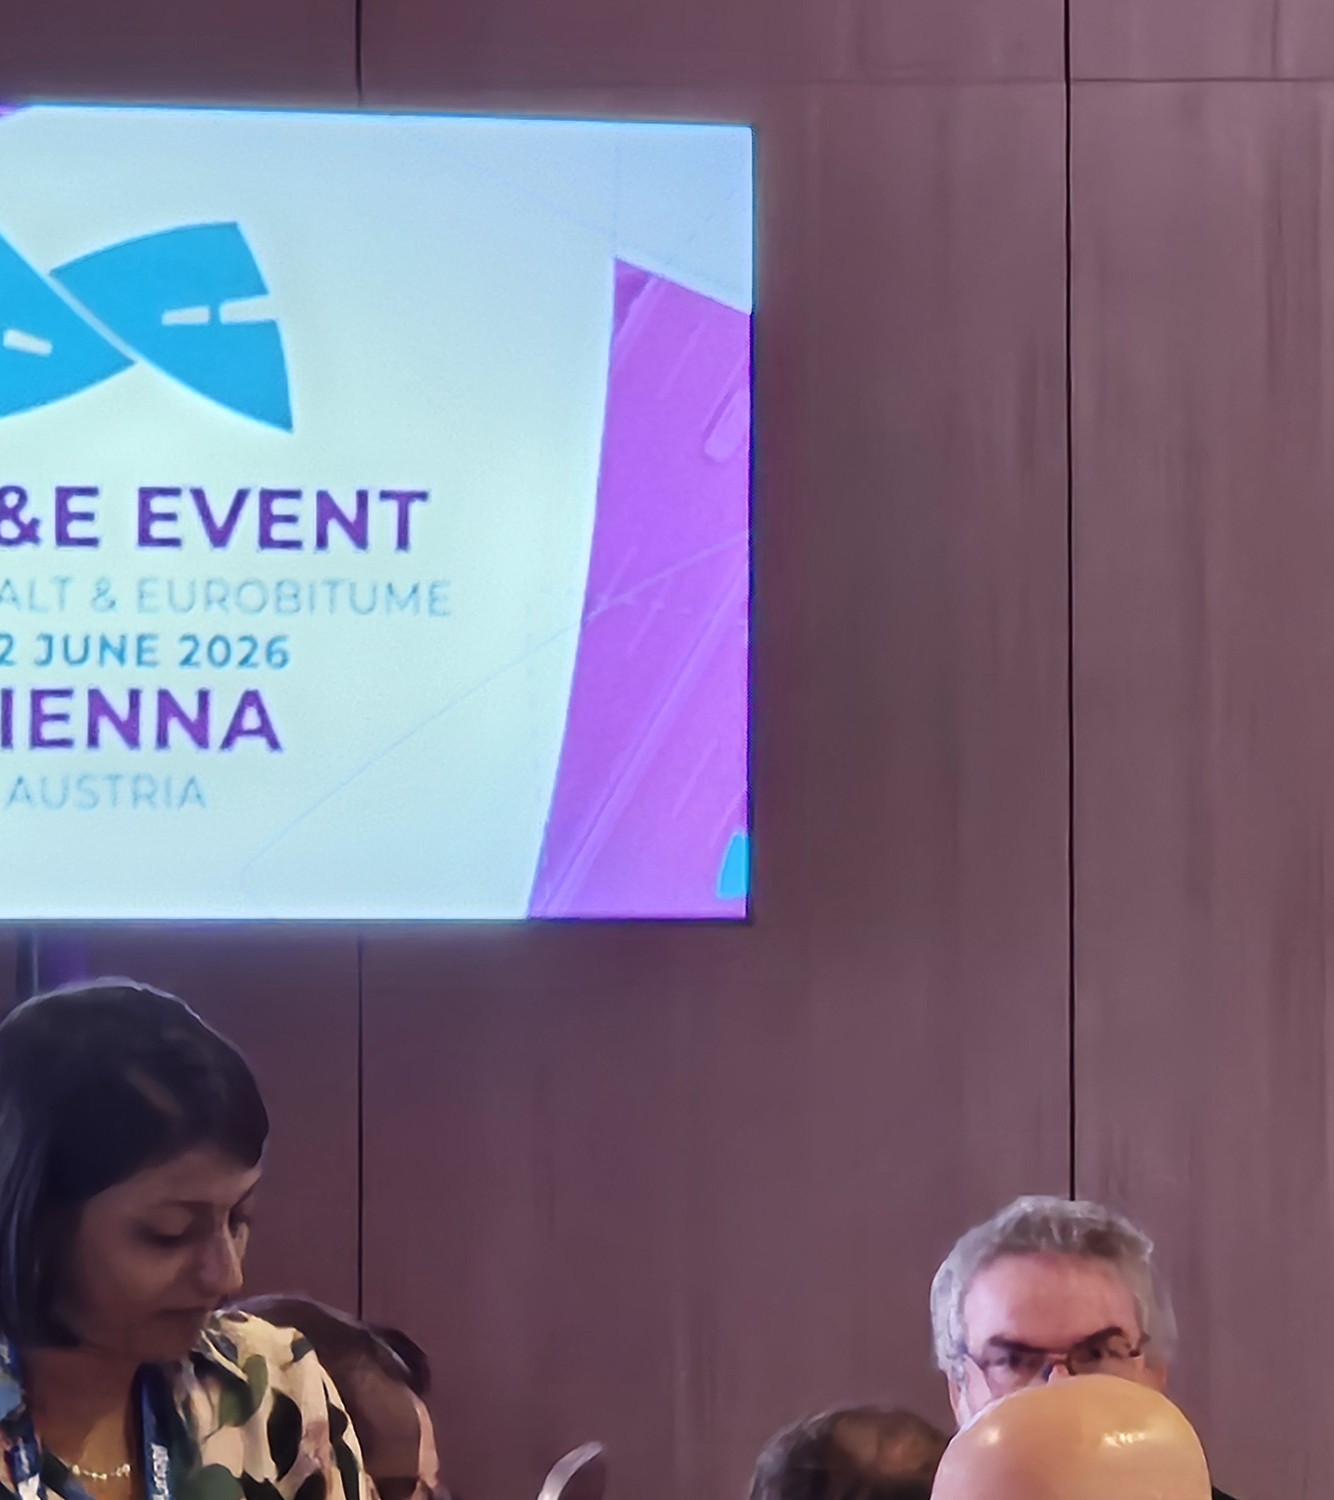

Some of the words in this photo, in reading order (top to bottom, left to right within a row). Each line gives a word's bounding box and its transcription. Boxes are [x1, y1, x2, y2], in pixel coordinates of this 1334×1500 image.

[136, 486, 430, 553] EVENT
[90, 575, 118, 614] &
[136, 577, 452, 618] EUROBITUME
[33, 631, 160, 669] JUNE
[178, 633, 291, 671] 2026
[4, 772, 208, 812] AUSTRIA
